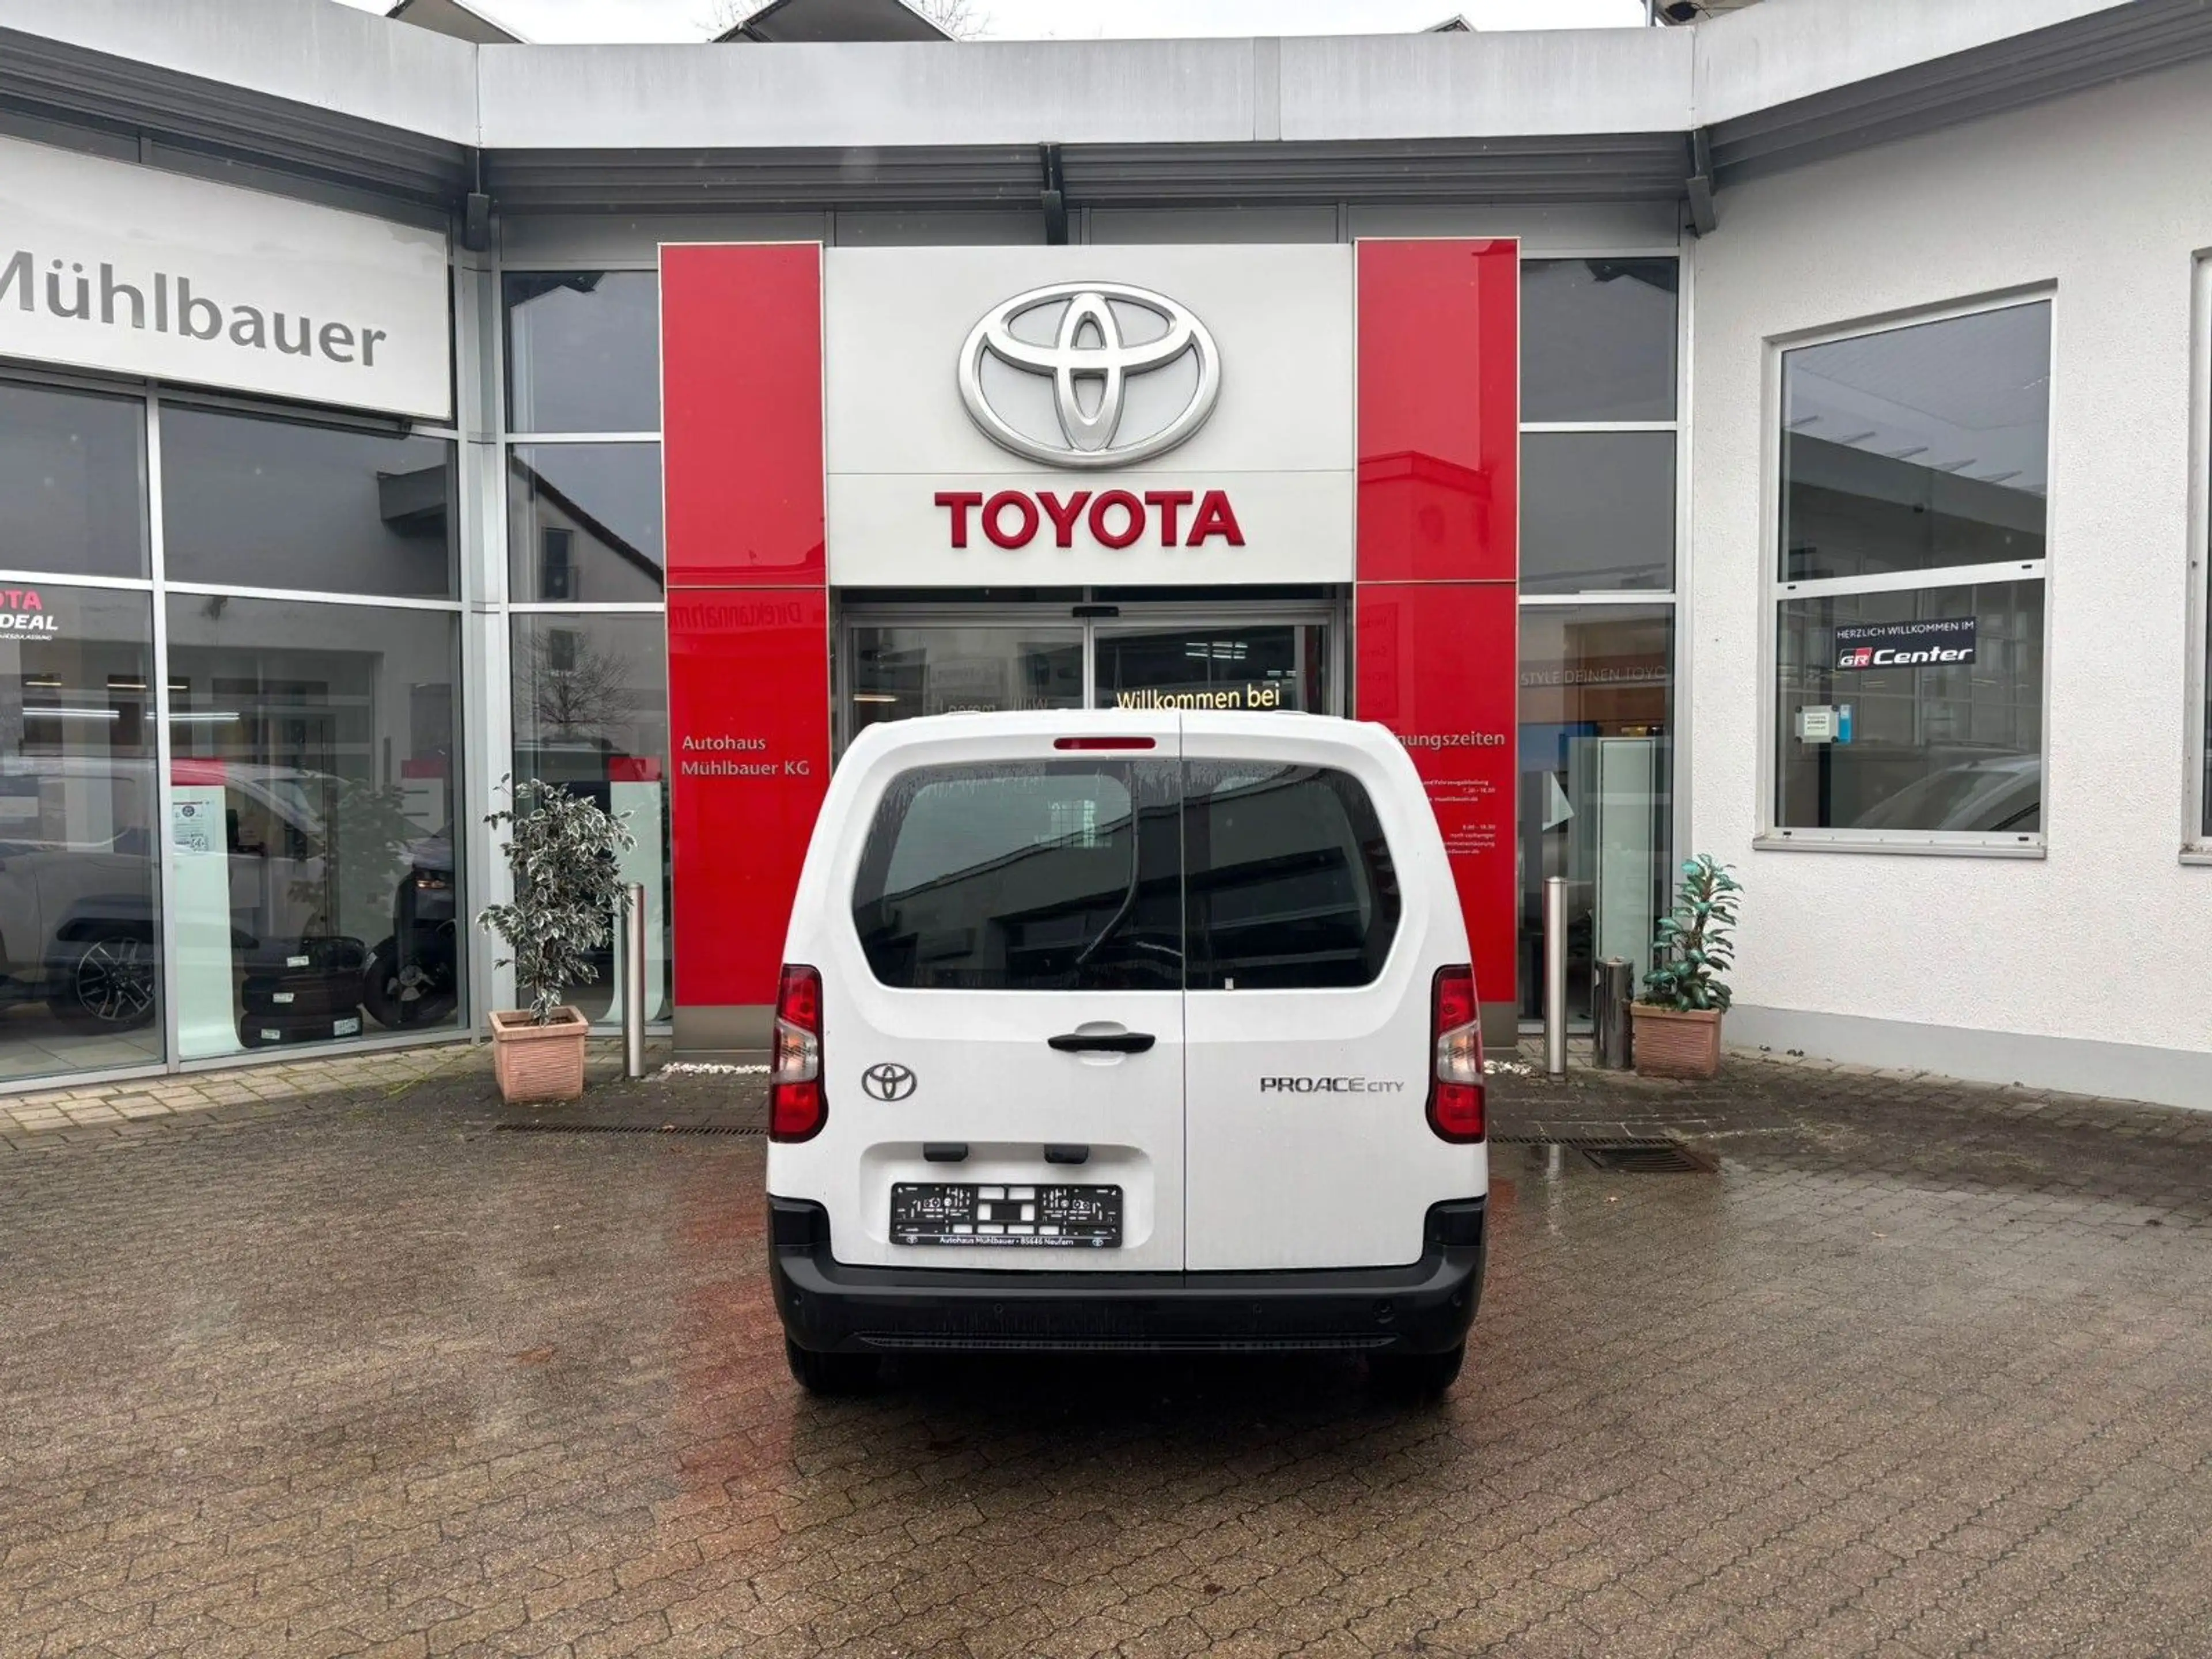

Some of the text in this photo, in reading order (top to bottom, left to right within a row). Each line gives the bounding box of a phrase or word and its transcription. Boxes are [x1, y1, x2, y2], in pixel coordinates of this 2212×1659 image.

[934, 490, 1245, 550] TOYOTA
[0, 590, 42, 611] TA
[1836, 620, 1974, 639] HERZLICH WILLKOMMEN IM
[1839, 645, 1974, 667] GR Center
[1521, 670, 1560, 685] STYLE
[1116, 683, 1280, 710] Willkommen bei
[682, 734, 766, 750] Autohaus
[681, 760, 810, 775] Mühlbauer KG
[1260, 1077, 1404, 1093] PROACE CITY
